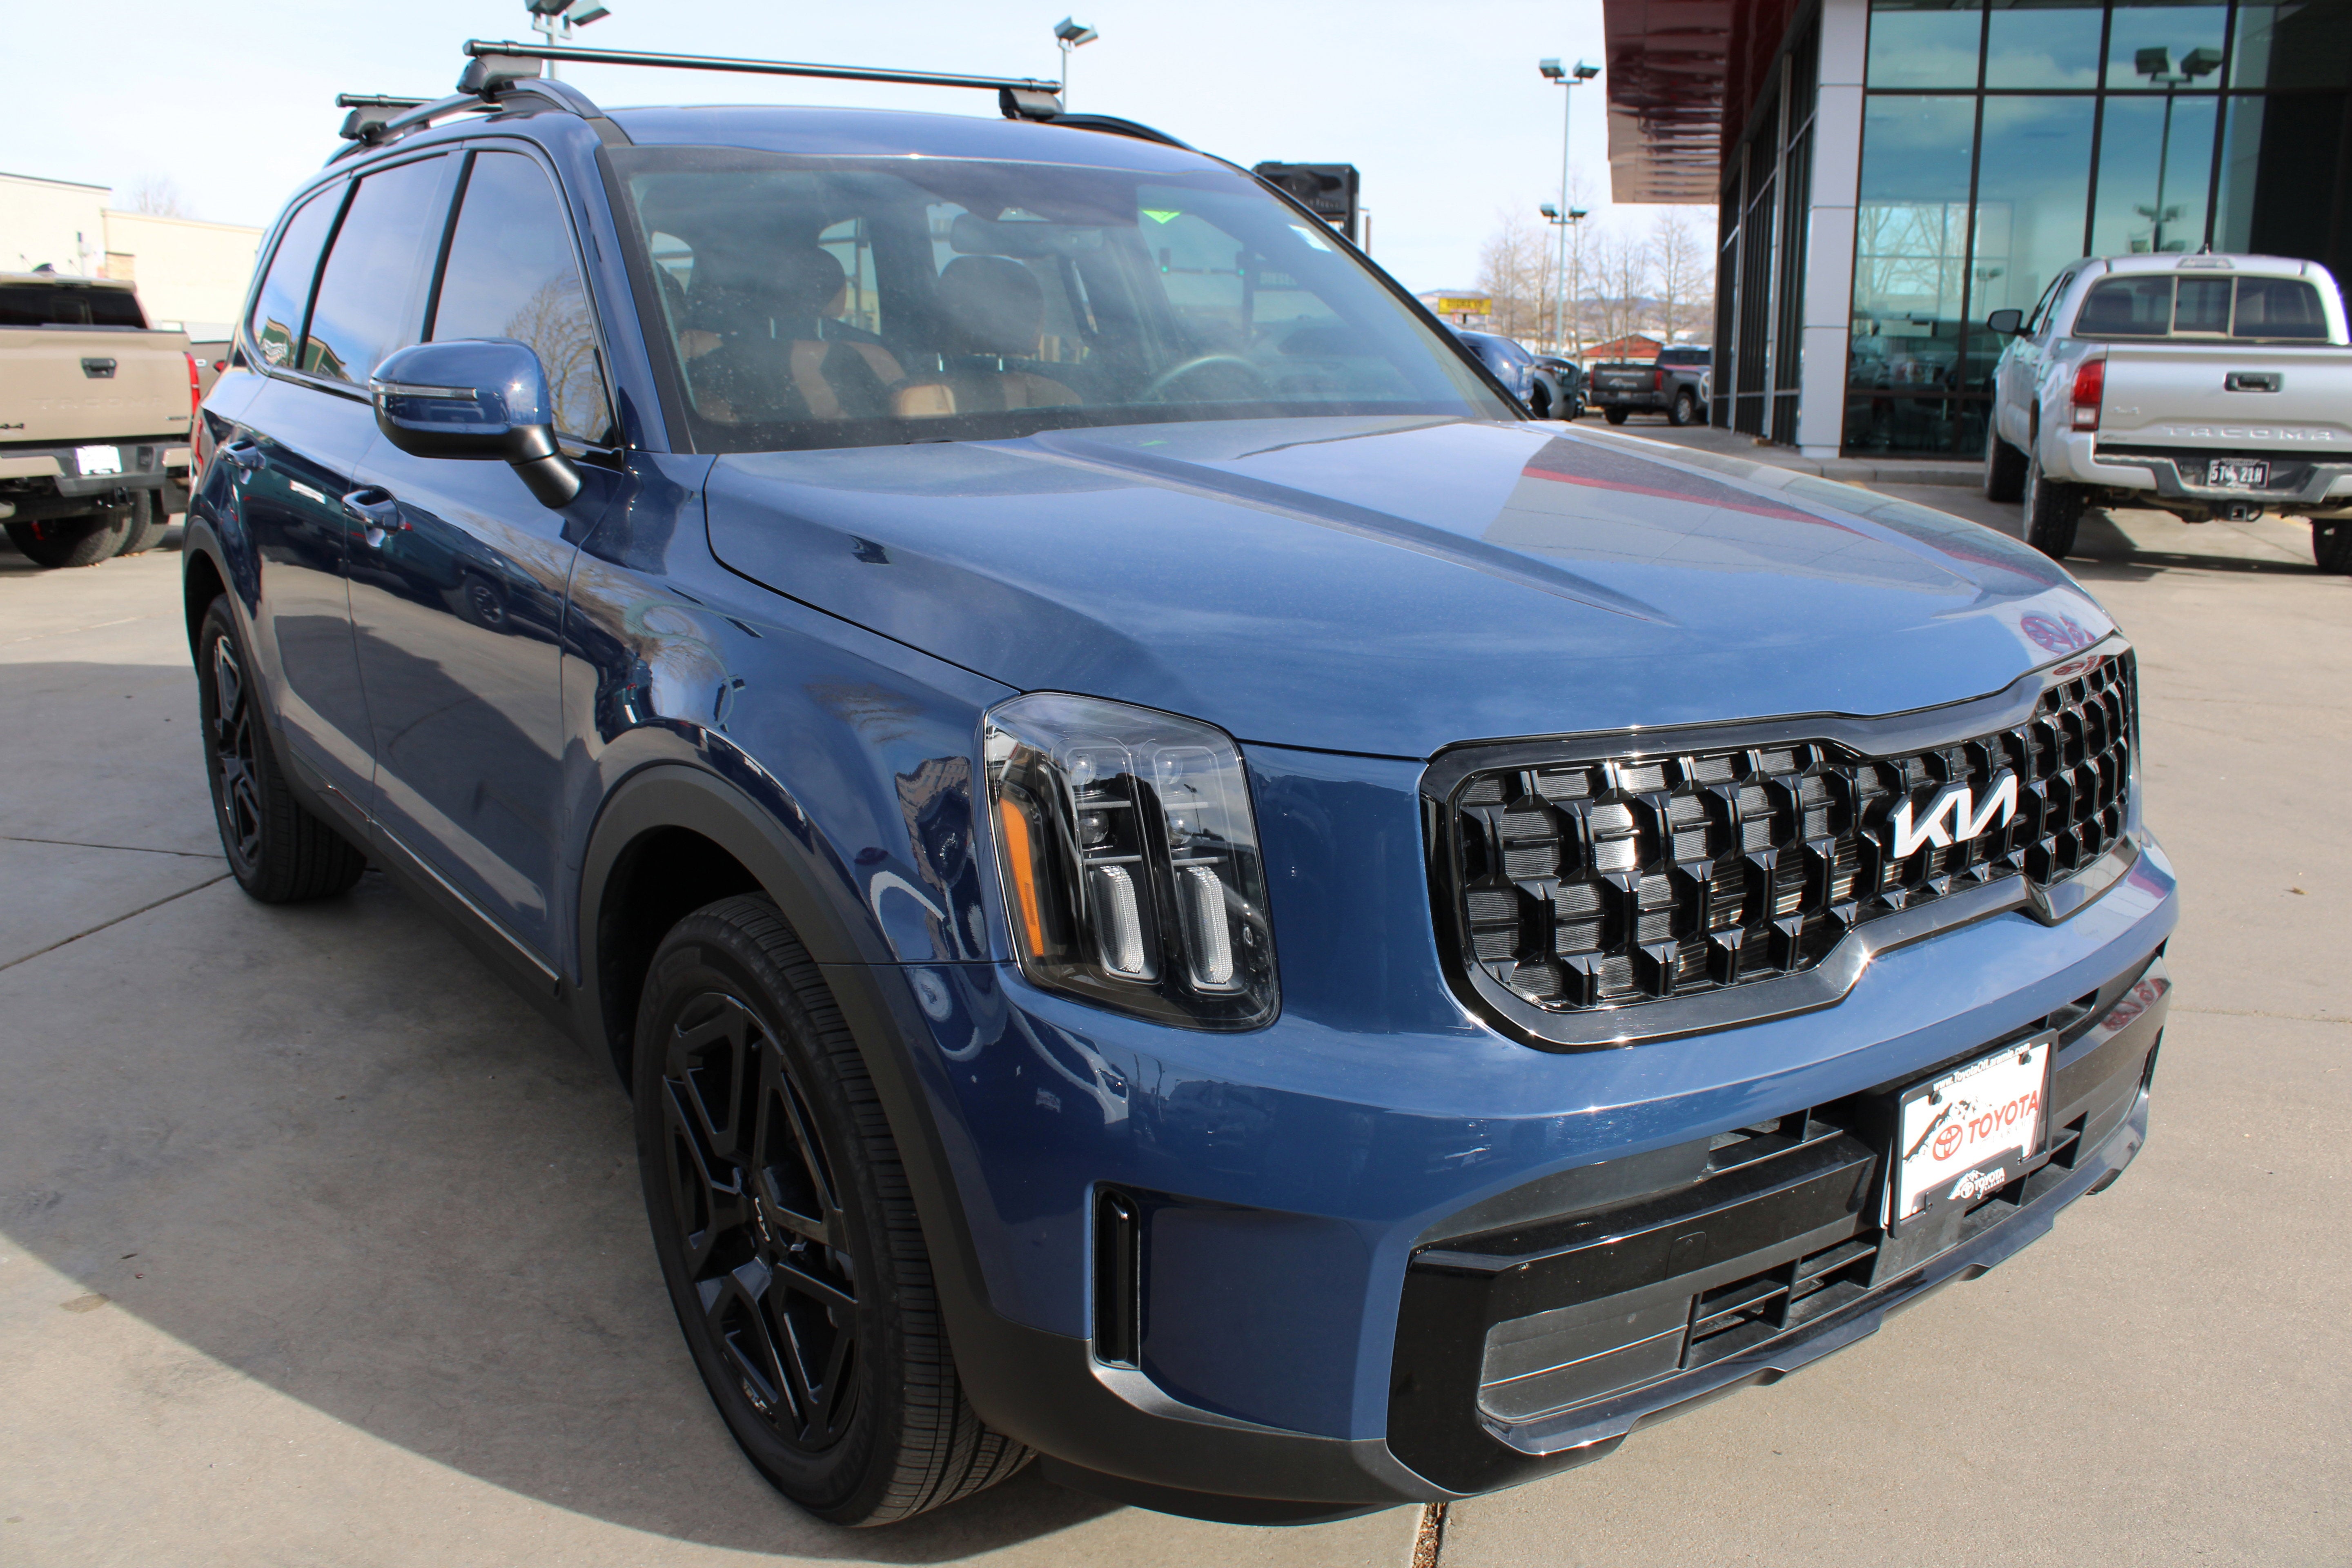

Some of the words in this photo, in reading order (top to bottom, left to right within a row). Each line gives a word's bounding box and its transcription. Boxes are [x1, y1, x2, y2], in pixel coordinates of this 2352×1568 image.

[2163, 426, 2334, 440] TACOMA
[1892, 773, 2018, 859] KIA
[1933, 1042, 2031, 1091] www.ToyotaOfLaramie.com
[1969, 1090, 2038, 1143] TOYOTA
[1974, 1167, 2005, 1191] TOYOTA
